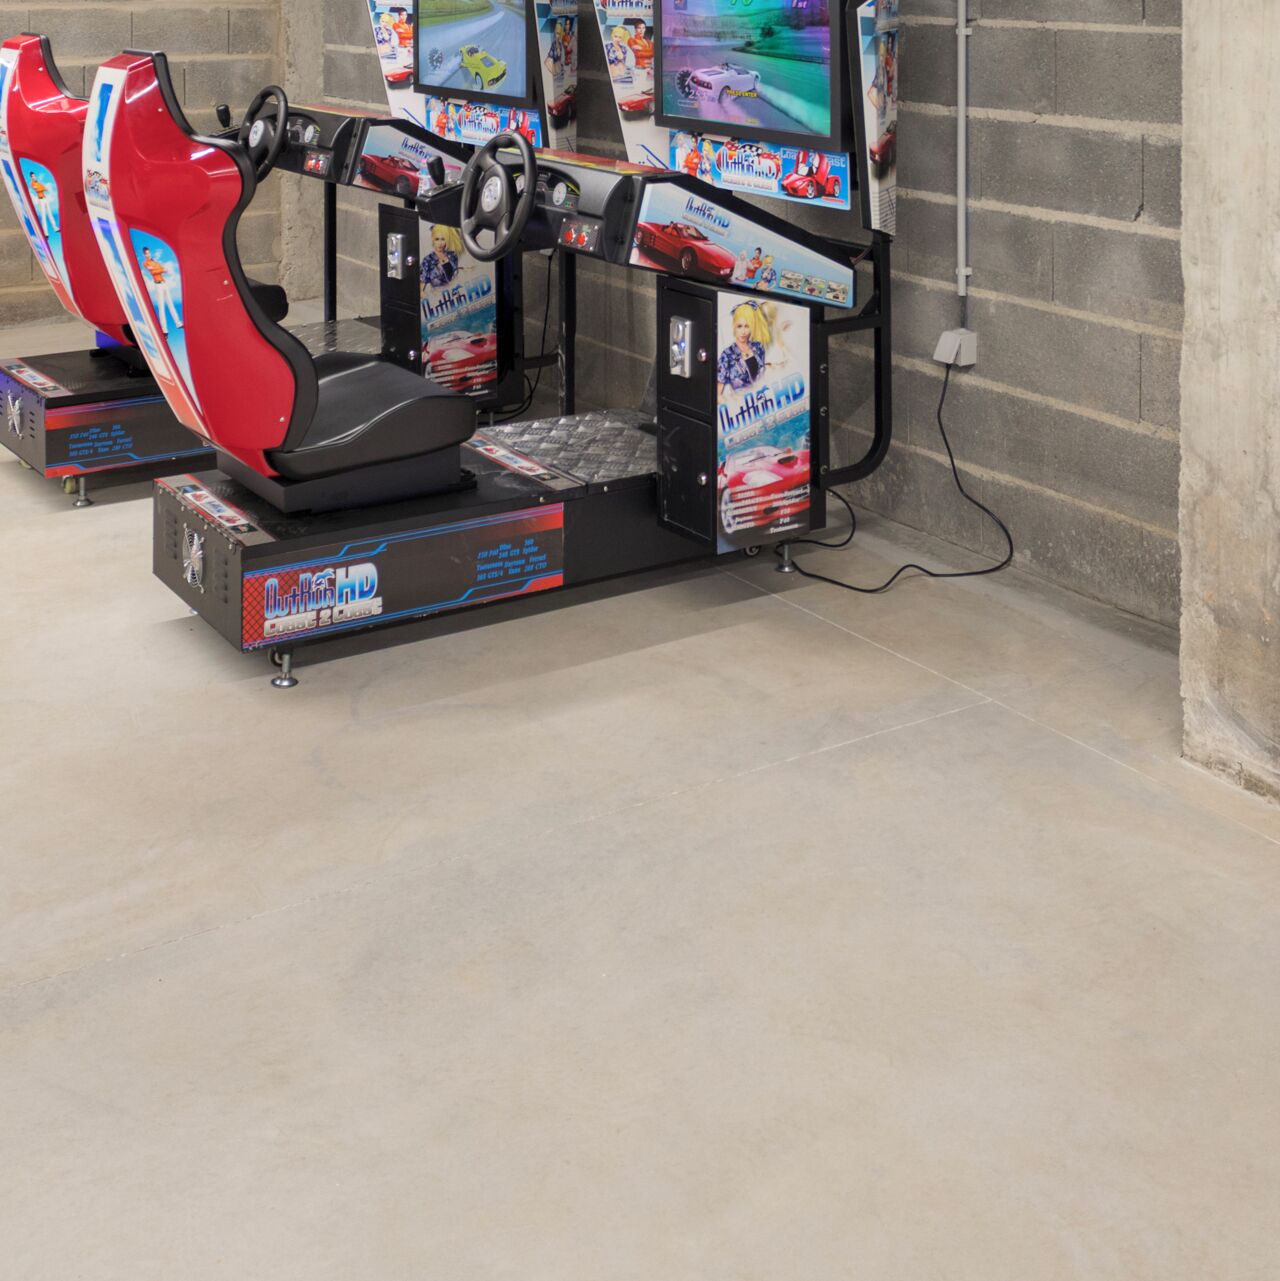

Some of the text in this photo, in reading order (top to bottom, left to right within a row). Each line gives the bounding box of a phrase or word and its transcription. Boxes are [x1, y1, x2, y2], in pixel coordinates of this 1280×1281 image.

[719, 389, 774, 435] OutRun
[771, 372, 806, 410] HD
[264, 562, 378, 619] OutRun HD
